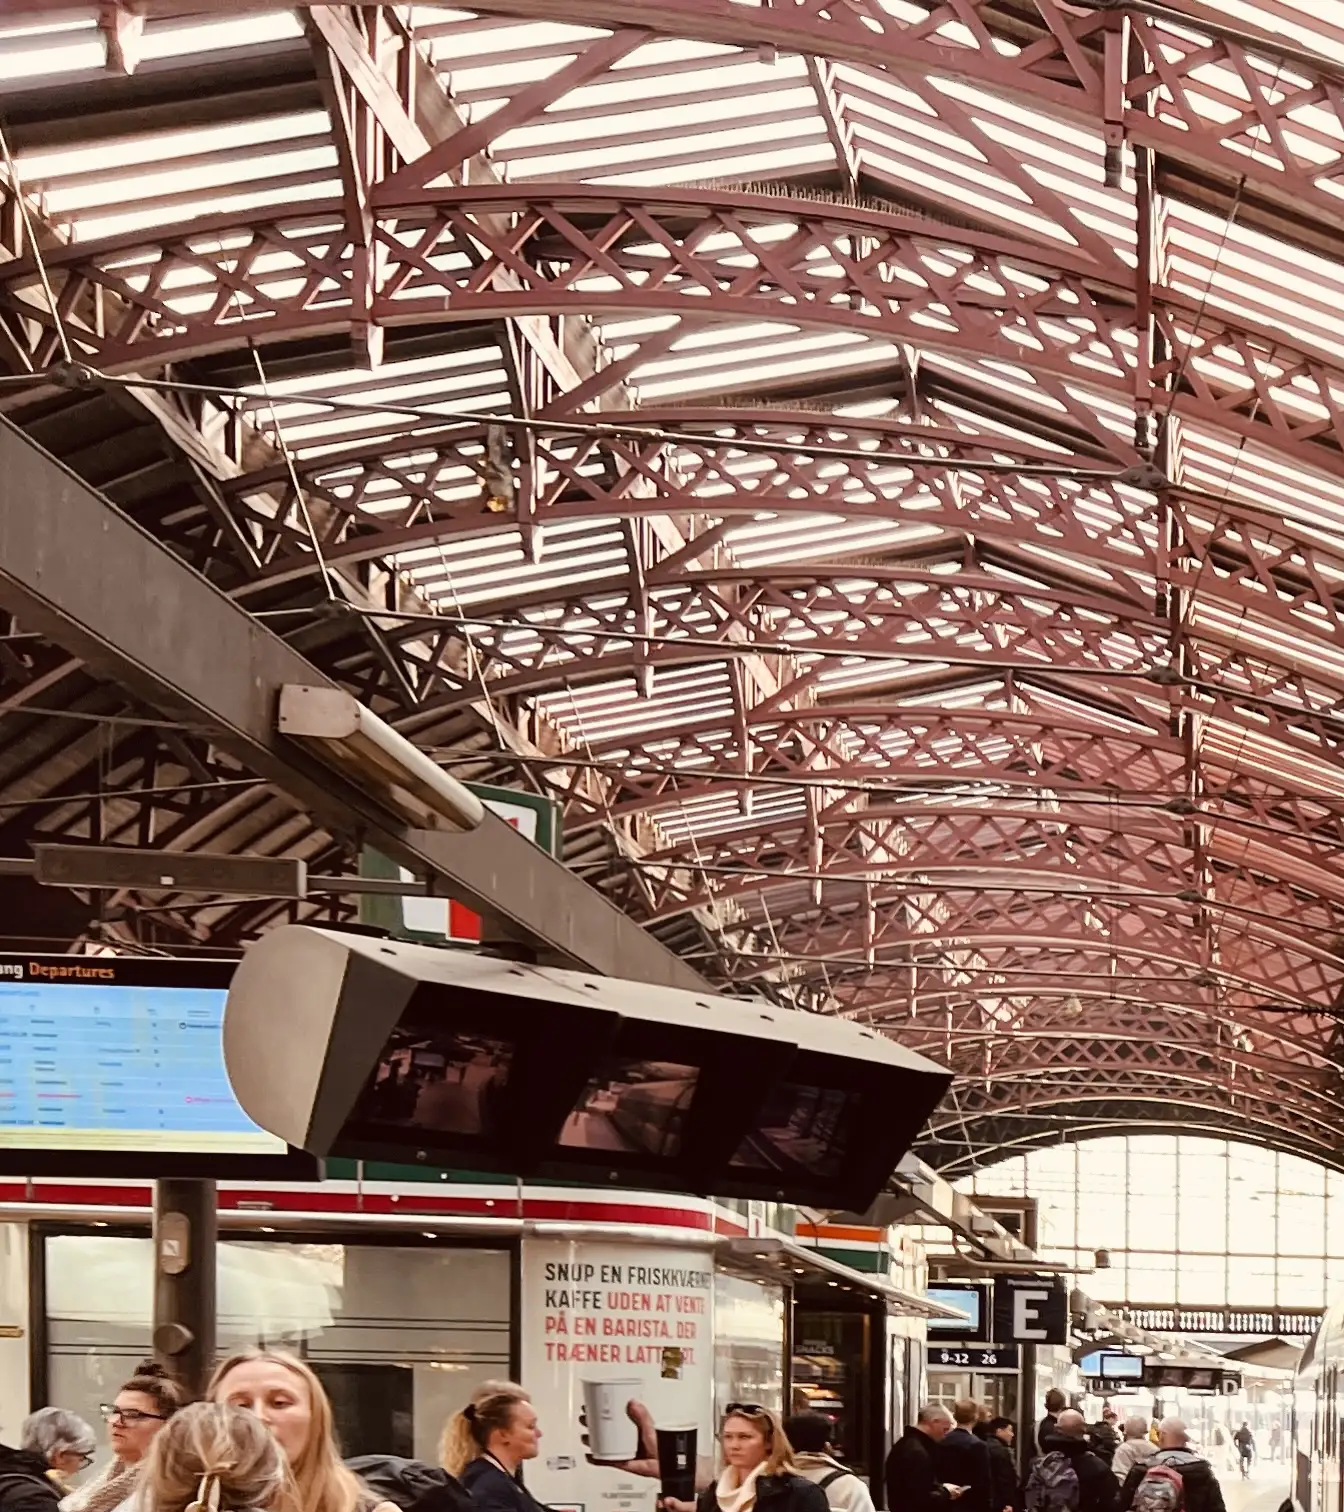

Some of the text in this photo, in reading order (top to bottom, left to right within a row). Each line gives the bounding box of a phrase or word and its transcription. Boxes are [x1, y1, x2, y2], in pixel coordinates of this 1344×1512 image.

[29, 961, 116, 980] Departures
[544, 1262, 595, 1283] SNUP
[600, 1264, 622, 1285] EN
[545, 1289, 602, 1310] KAFFE
[607, 1291, 651, 1312] UDEN
[655, 1294, 672, 1313] AT
[544, 1310, 569, 1335] PÅ
[574, 1317, 597, 1336] EN
[676, 1321, 697, 1340] DER
[1012, 1290, 1049, 1341] E
[544, 1342, 621, 1364] TRÆNER
[626, 1345, 665, 1365] LATT
[980, 1353, 997, 1365] 26
